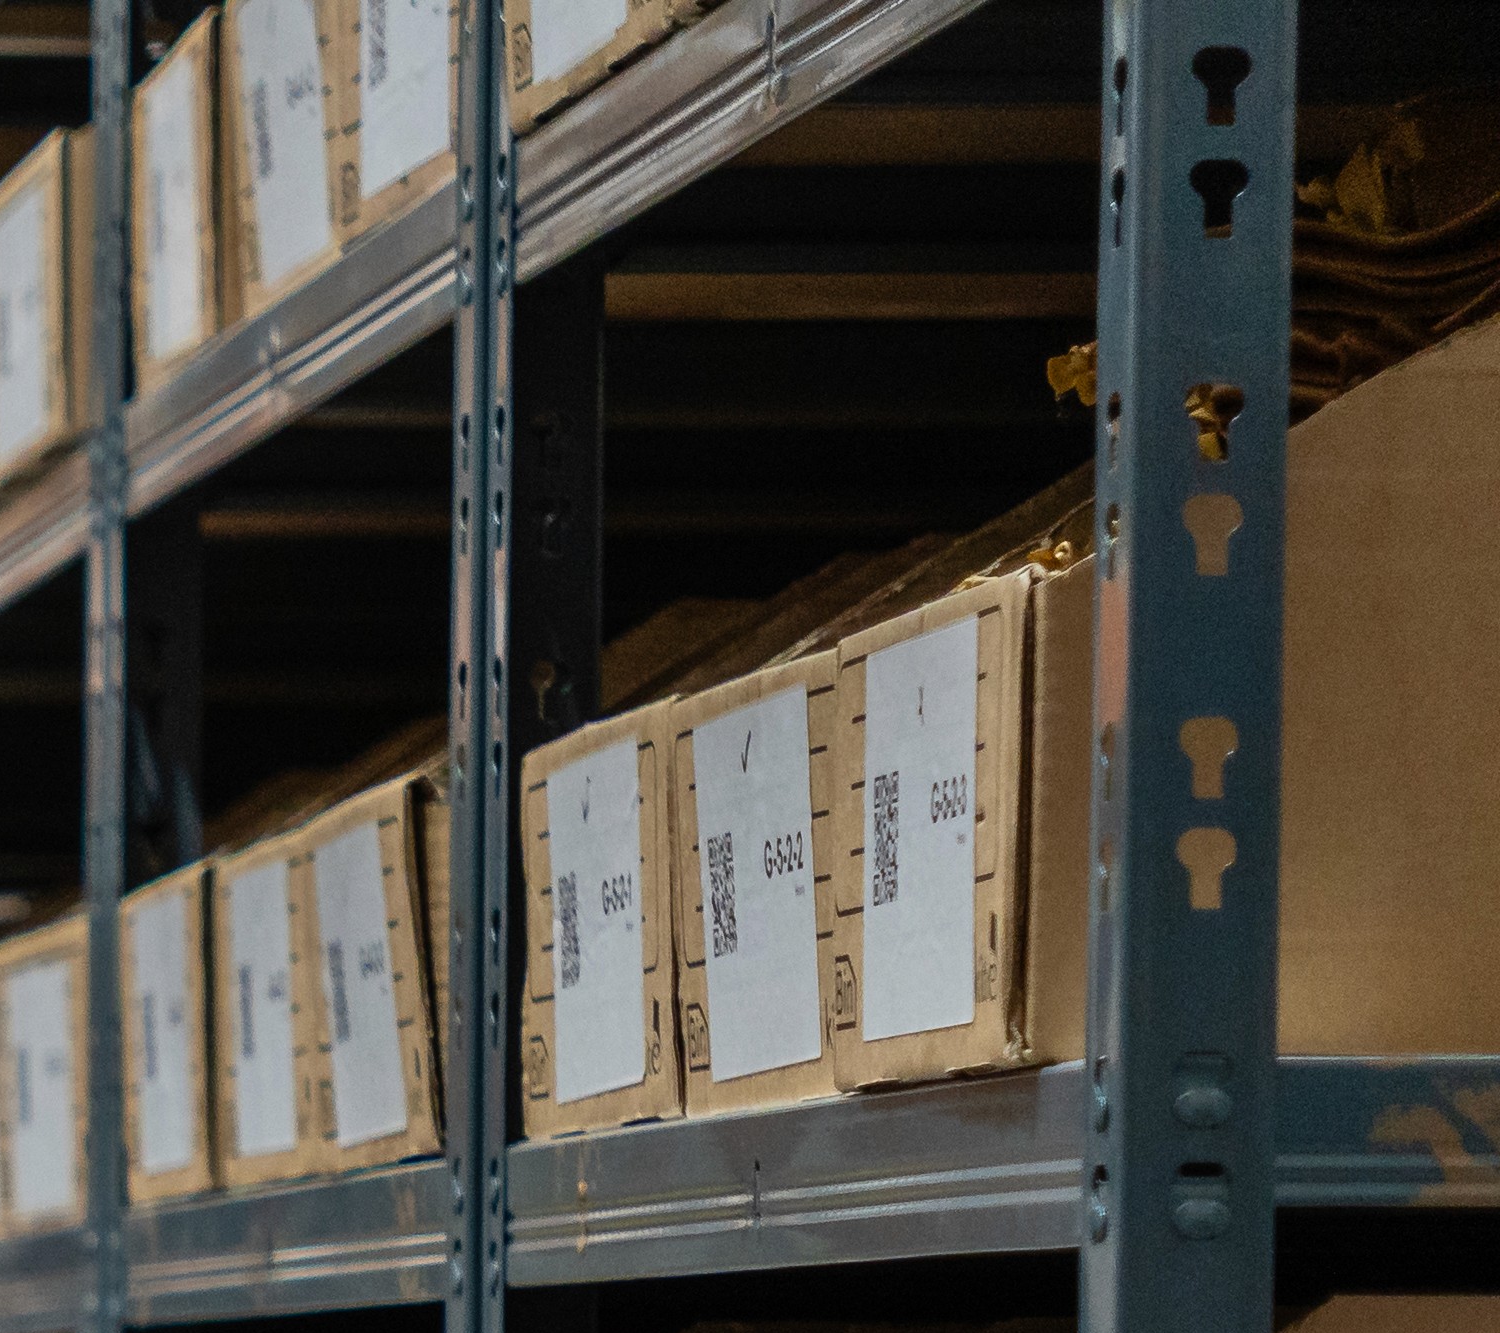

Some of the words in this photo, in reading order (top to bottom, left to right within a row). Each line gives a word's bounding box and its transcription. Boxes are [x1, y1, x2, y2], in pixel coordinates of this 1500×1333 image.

[931, 774, 968, 824] G-5-2-3
[764, 831, 804, 879] G-5-2-2
[835, 968, 854, 1015] Bin
